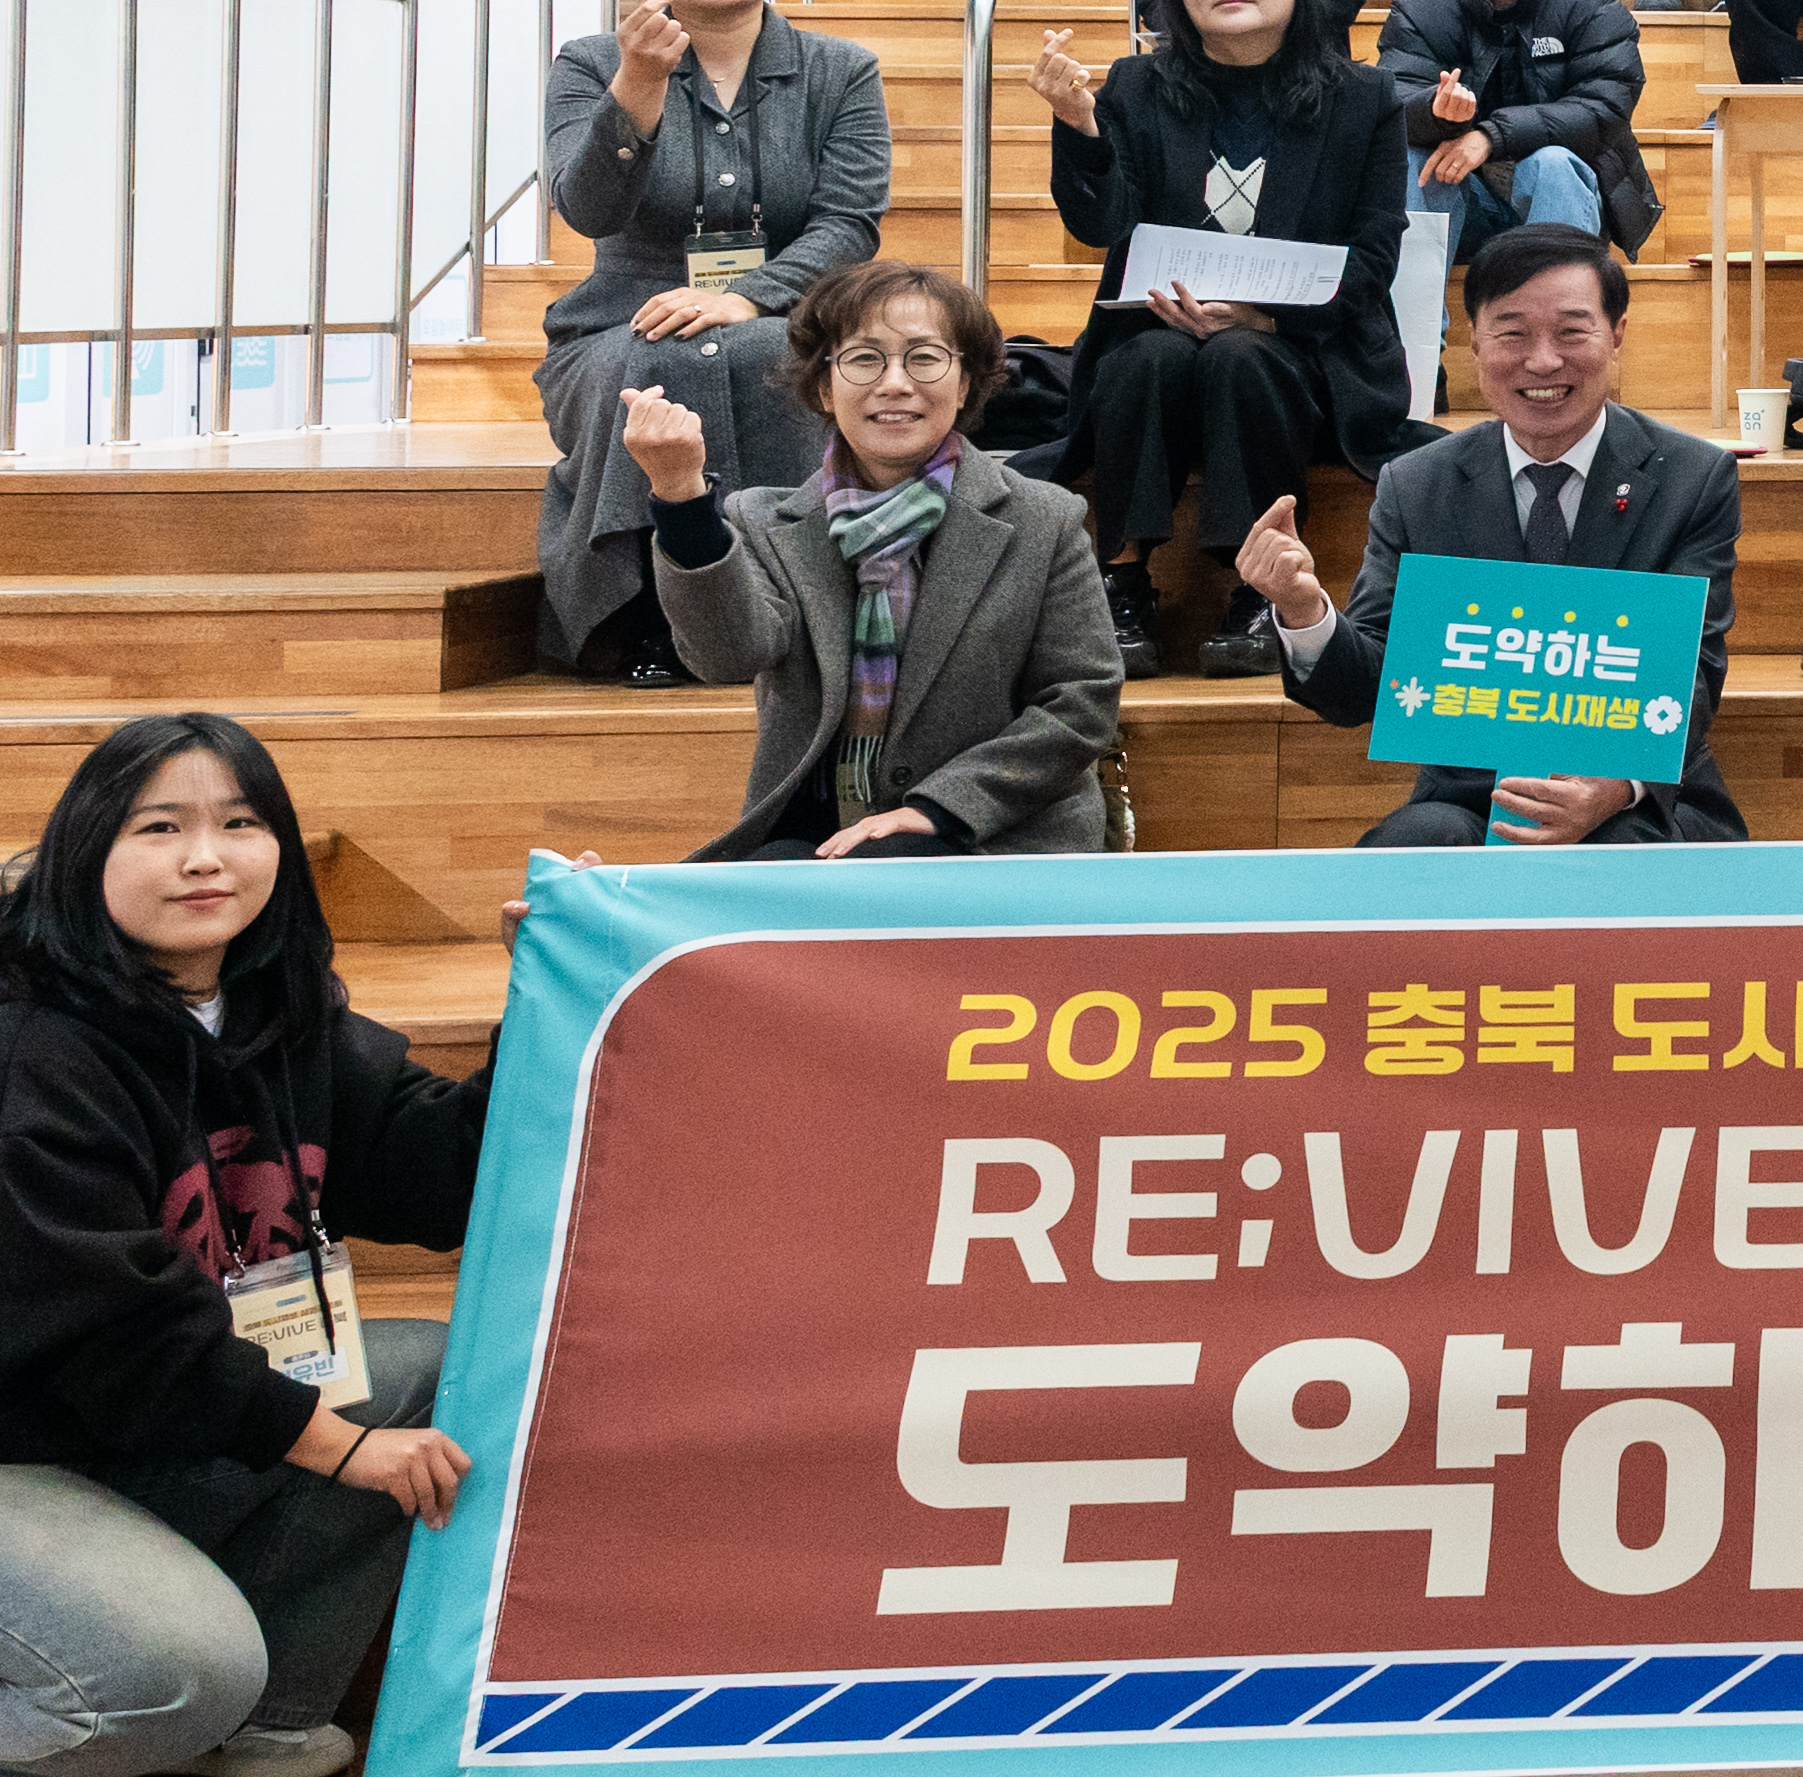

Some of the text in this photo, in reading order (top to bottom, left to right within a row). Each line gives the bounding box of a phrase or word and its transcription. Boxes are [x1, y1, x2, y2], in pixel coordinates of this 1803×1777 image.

[1441, 622, 1641, 682] 도약하는
[1432, 683, 1641, 730] 충북 도시재생
[947, 988, 1328, 1081] 2025
[1363, 984, 1576, 1076] 충북
